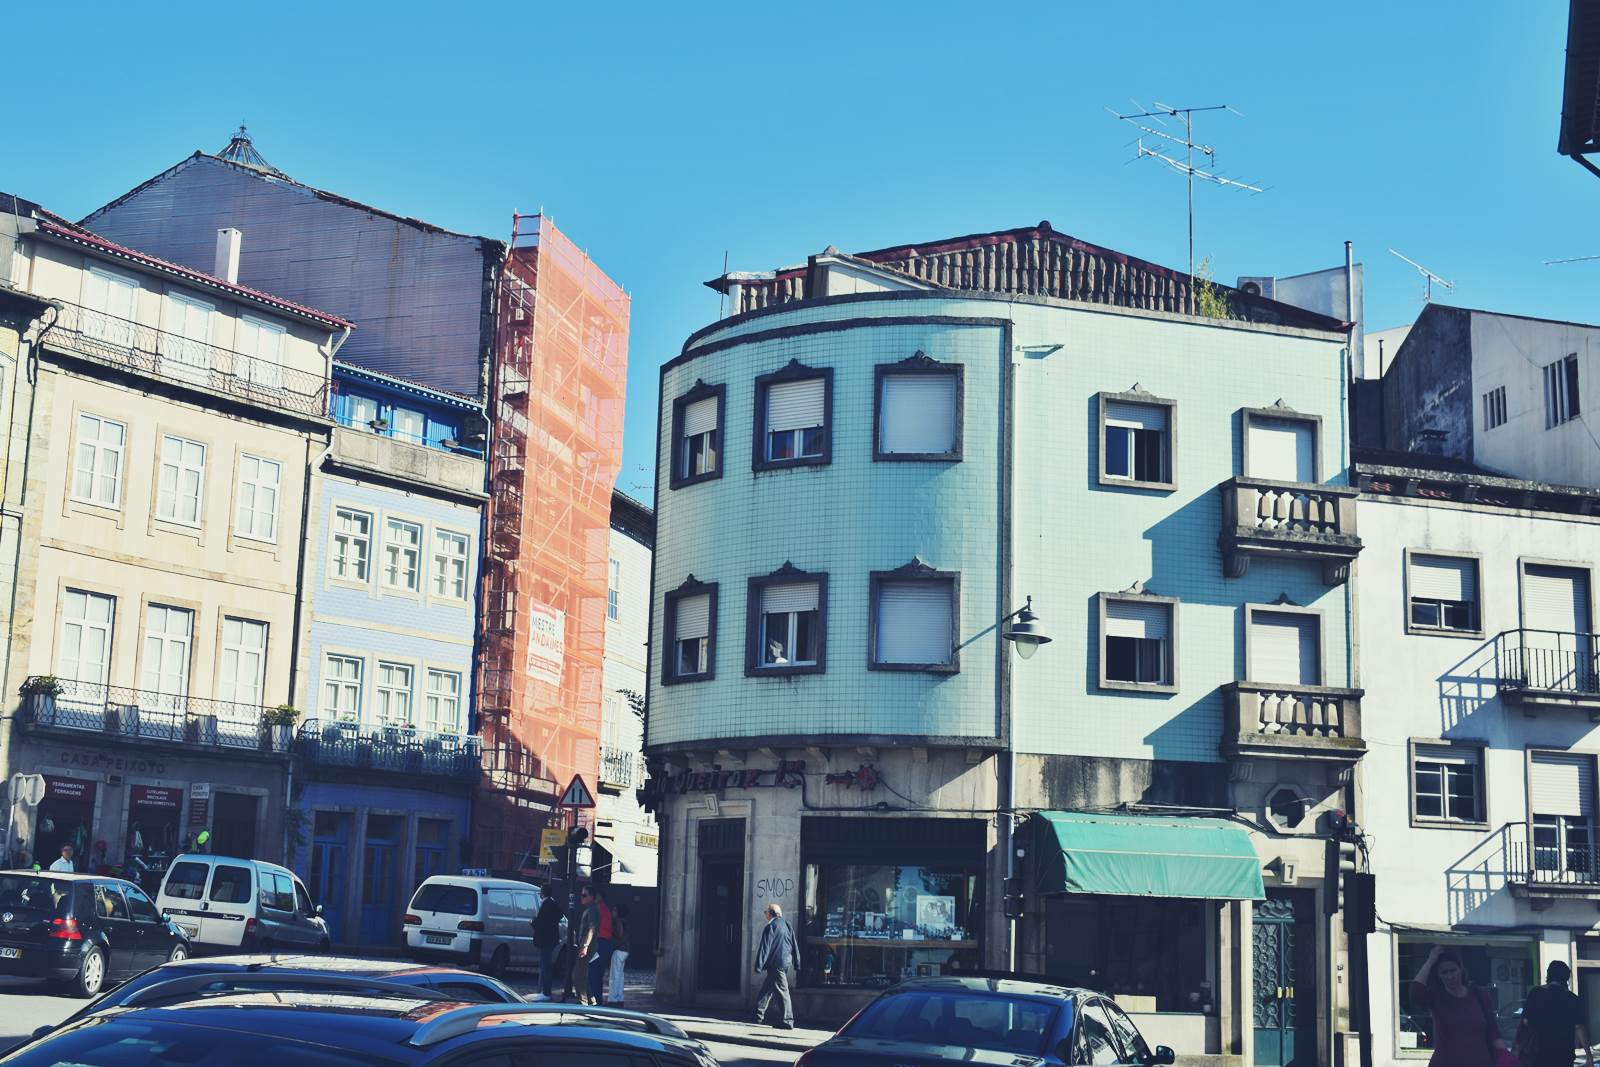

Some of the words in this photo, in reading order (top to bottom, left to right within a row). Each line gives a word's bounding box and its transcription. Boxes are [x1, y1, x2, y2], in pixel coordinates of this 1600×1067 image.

[532, 615, 556, 637] MESTRE
[531, 630, 563, 655] ANDAIMES
[61, 752, 100, 770] CASA
[104, 757, 166, 775] PEIXOTO
[756, 877, 794, 898] SMOP
